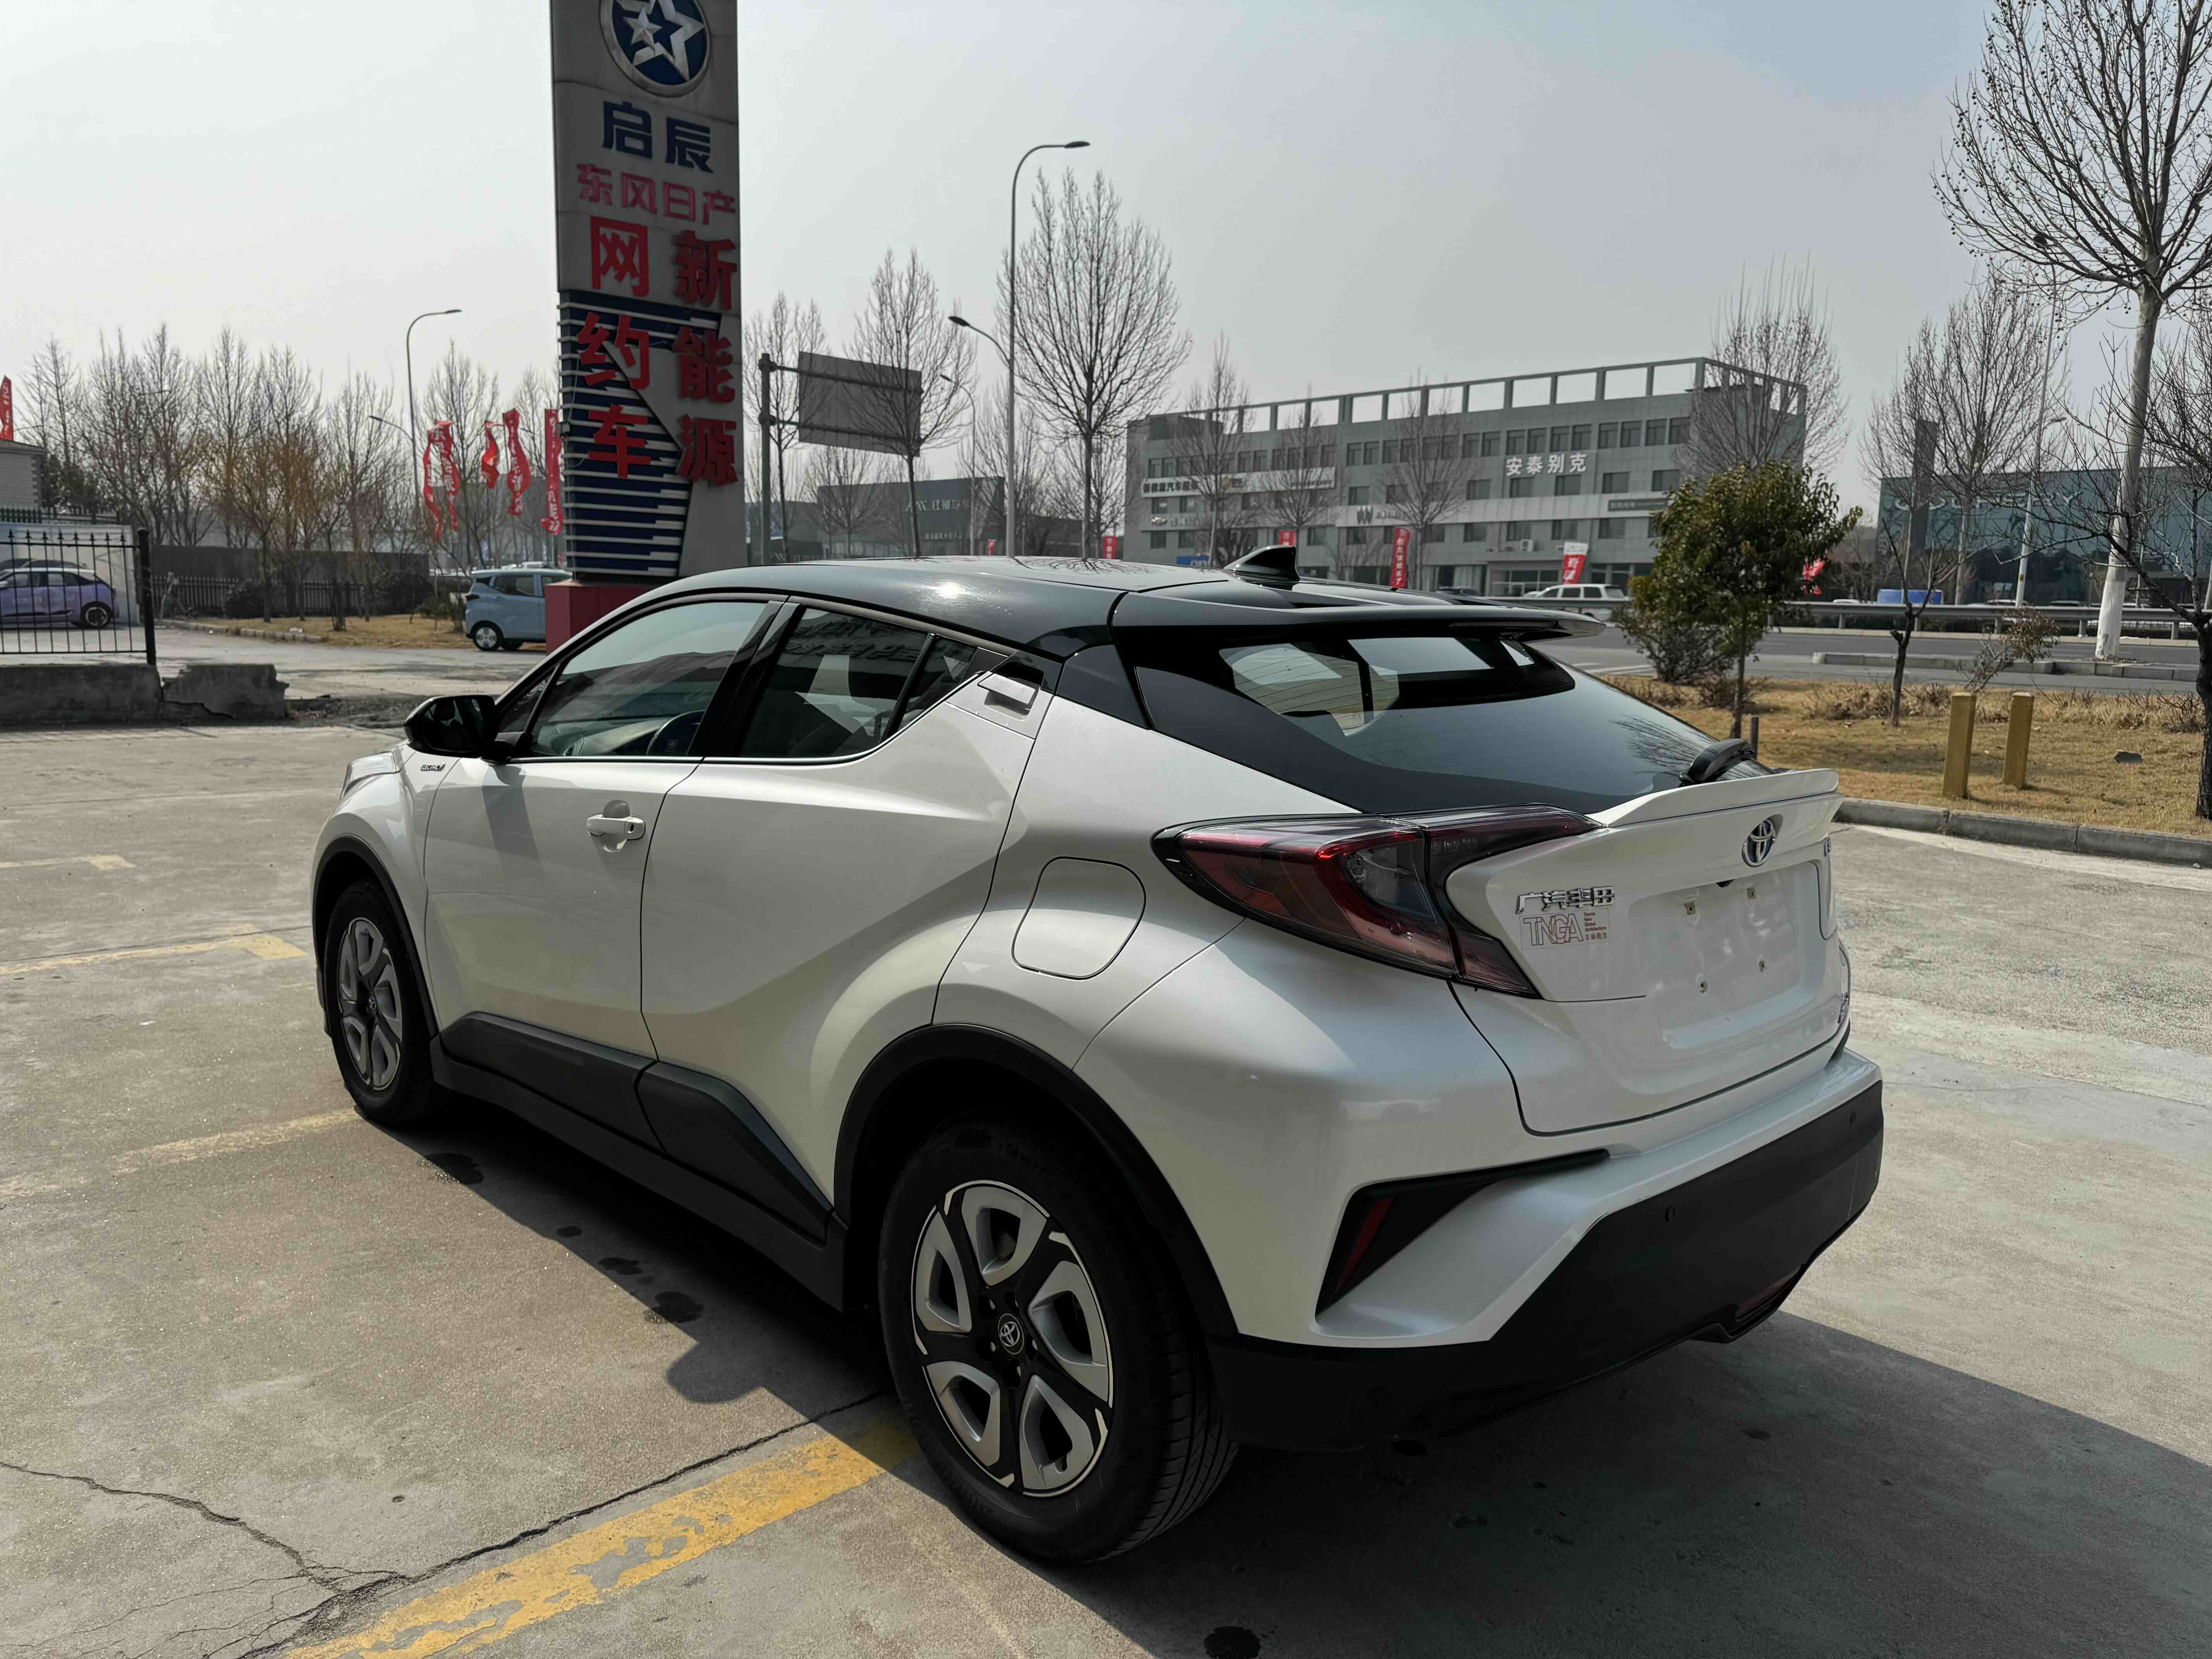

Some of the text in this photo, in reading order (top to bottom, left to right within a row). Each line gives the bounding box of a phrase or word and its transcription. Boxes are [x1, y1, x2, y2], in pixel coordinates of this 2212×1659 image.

[602, 100, 713, 173] 启辰
[577, 163, 736, 225] 东风日产
[577, 216, 651, 478] 网约车
[673, 230, 738, 486] 新能源
[1506, 452, 1587, 476] 安泰别克
[1523, 914, 1583, 945] TNGA
